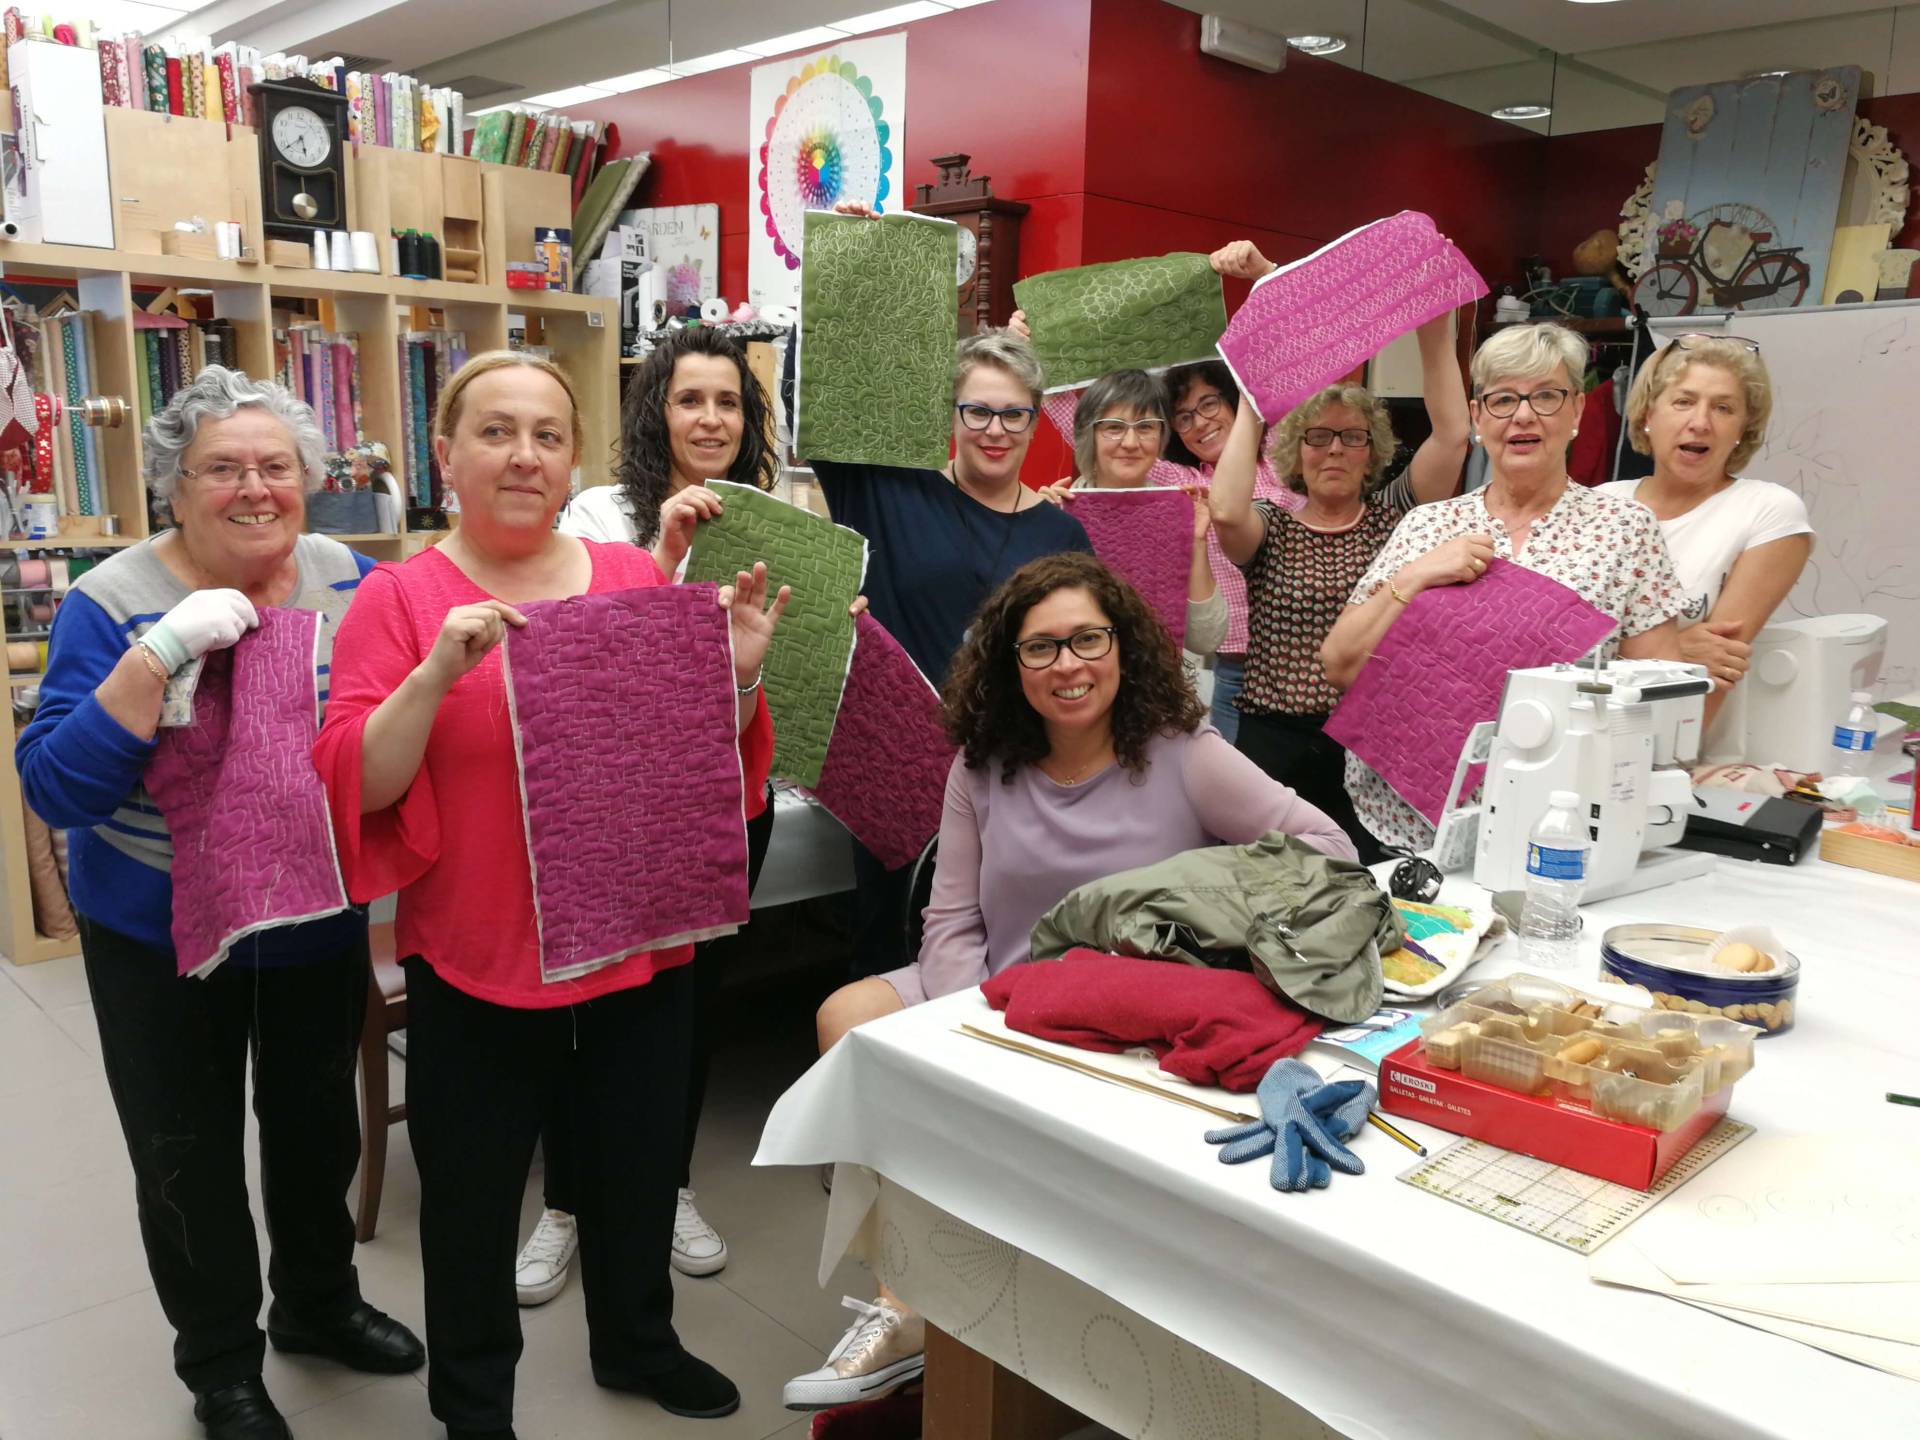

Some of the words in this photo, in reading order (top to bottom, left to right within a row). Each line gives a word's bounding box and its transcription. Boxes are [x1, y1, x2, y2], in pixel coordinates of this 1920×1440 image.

[1403, 1076, 1433, 1091] EROSKI
[1390, 1086, 1415, 1098] GALLETAS
[1447, 1103, 1471, 1116] GALETES
